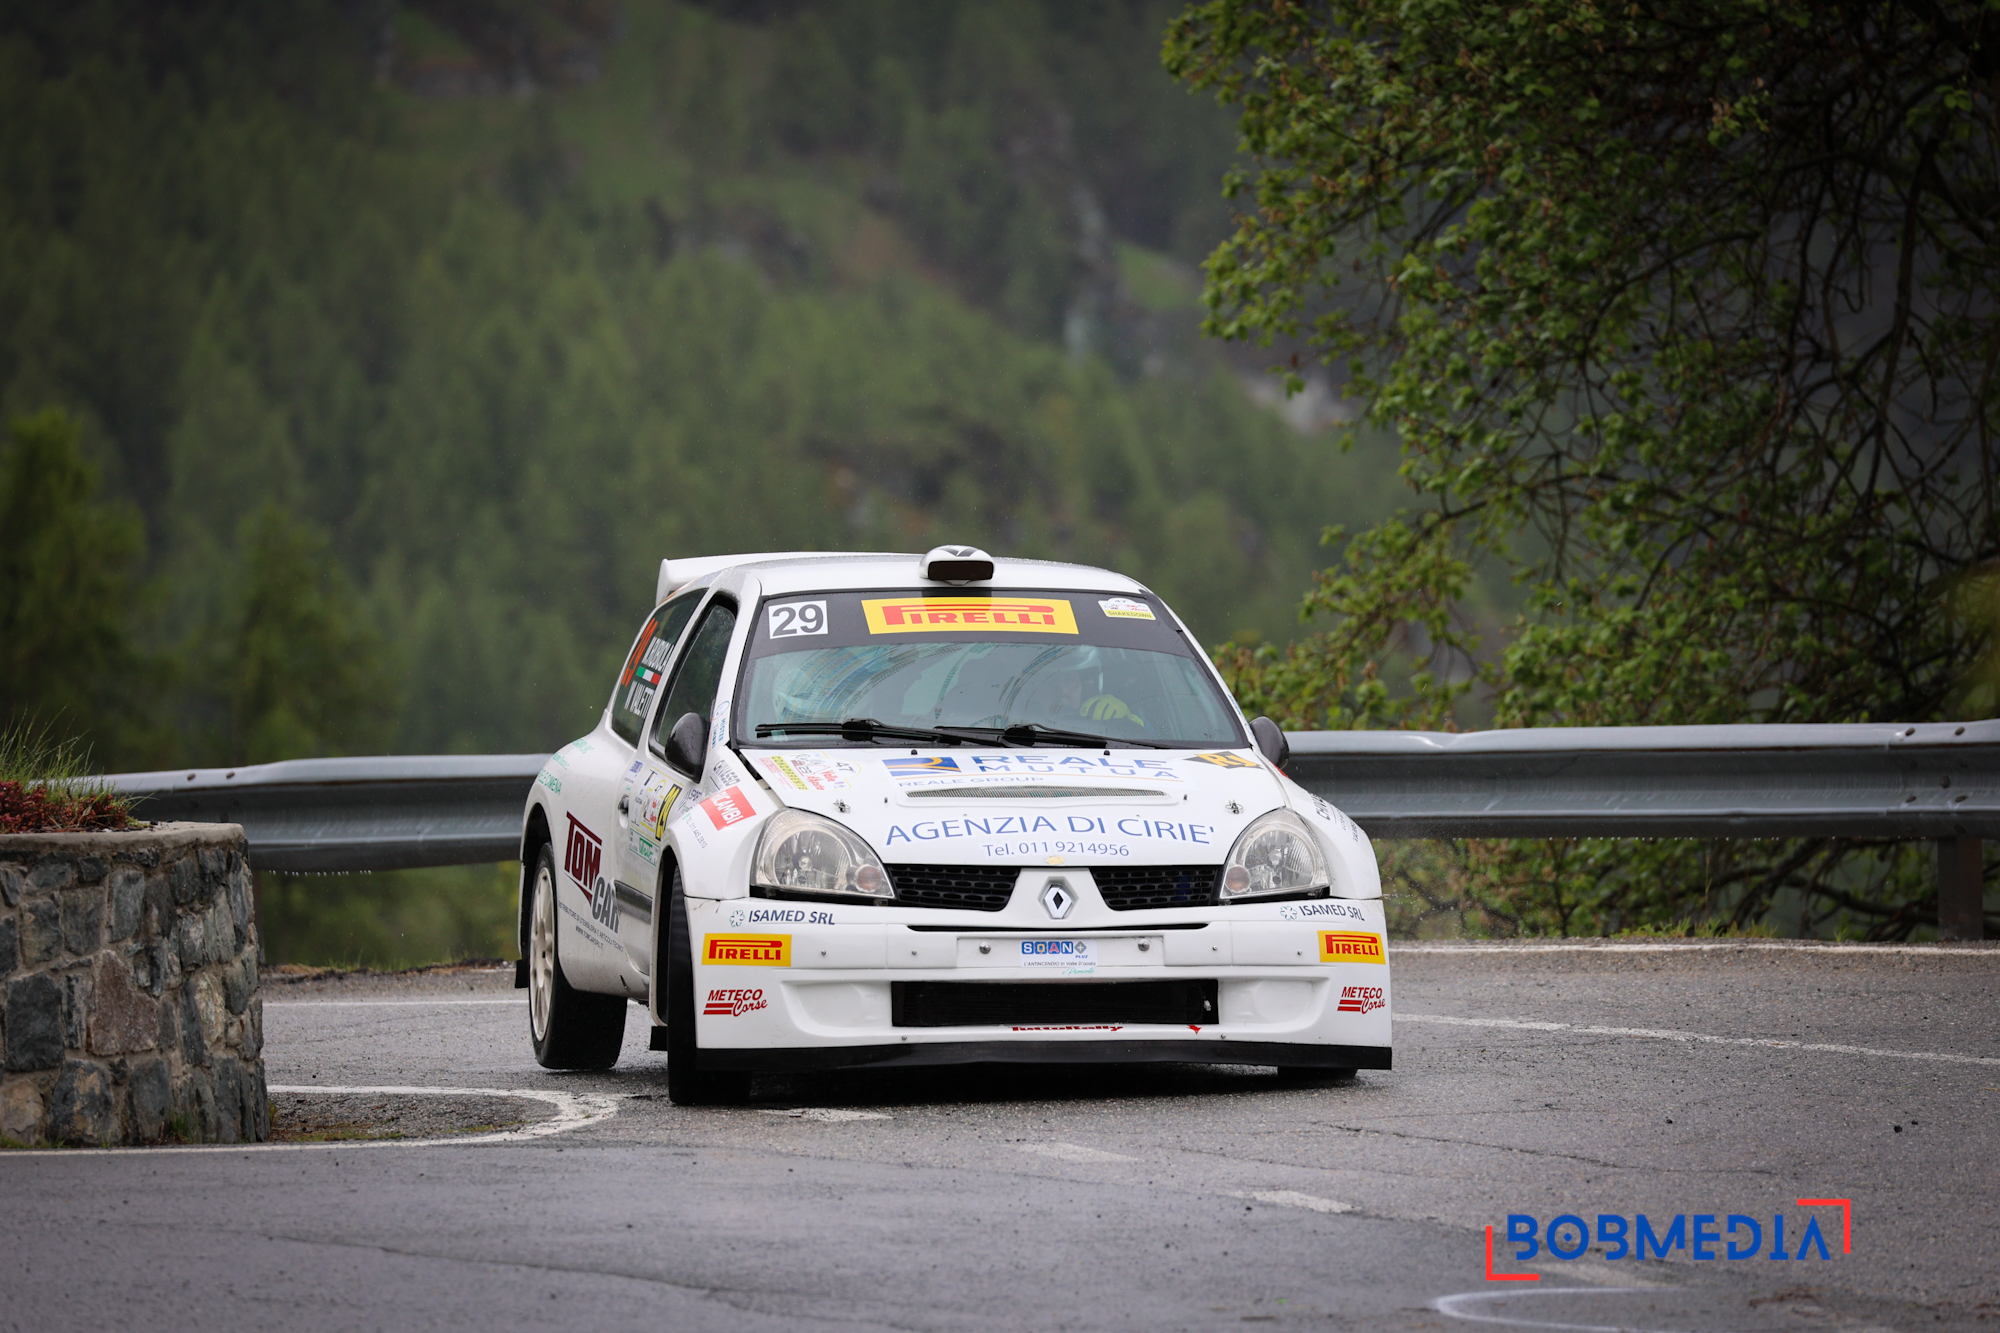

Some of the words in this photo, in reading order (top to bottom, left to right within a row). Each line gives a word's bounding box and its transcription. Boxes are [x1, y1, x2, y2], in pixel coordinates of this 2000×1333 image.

[772, 604, 824, 636] 29
[882, 604, 1055, 626] PIRELLI
[971, 756, 1174, 770] REALE
[978, 766, 1180, 778] MUTUA
[898, 778, 966, 787] REALE
[886, 816, 1058, 846] AGENZIA
[1067, 816, 1106, 834] DI
[1117, 818, 1215, 845] CIRIE'
[564, 810, 602, 891] TOM
[983, 844, 1014, 856] Tel.
[1018, 842, 1048, 854] 011
[1056, 841, 1130, 856] 9214956
[748, 910, 805, 922] ISAMED
[808, 912, 836, 925] SRL
[1298, 904, 1346, 916] ISAMED
[1347, 906, 1366, 922] SRL
[708, 940, 782, 960] PIRELLI
[1324, 934, 1380, 956] PIRELLI
[707, 989, 763, 1002] METECO
[1341, 986, 1382, 999] METECO
[732, 999, 768, 1017] Corse
[1361, 997, 1386, 1014] Corse
